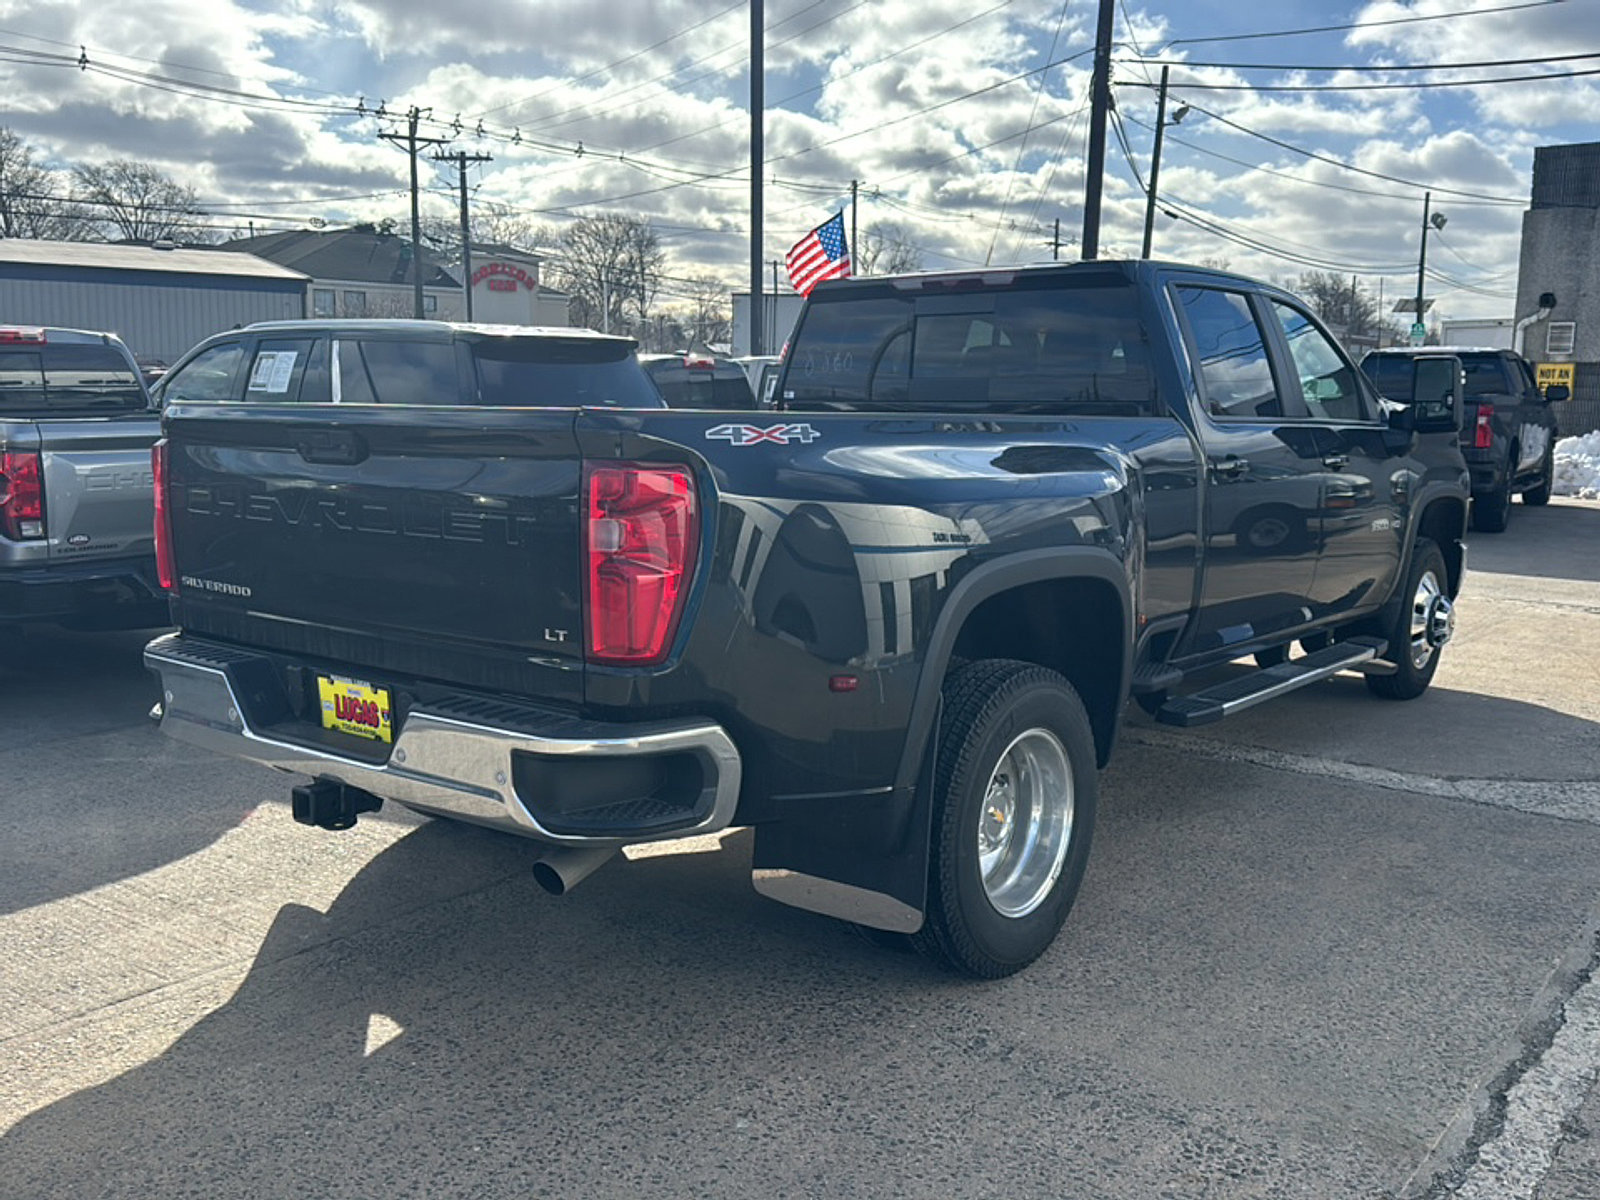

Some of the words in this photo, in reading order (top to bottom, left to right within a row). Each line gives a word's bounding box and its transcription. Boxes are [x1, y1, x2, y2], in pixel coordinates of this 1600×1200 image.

[1539, 368, 1556, 379] NOT
[1559, 368, 1570, 379] AN
[187, 489, 536, 545] CHEVROLET
[181, 576, 251, 597] SILVERADO
[544, 628, 568, 642] LT
[334, 694, 380, 728] LUCAS
